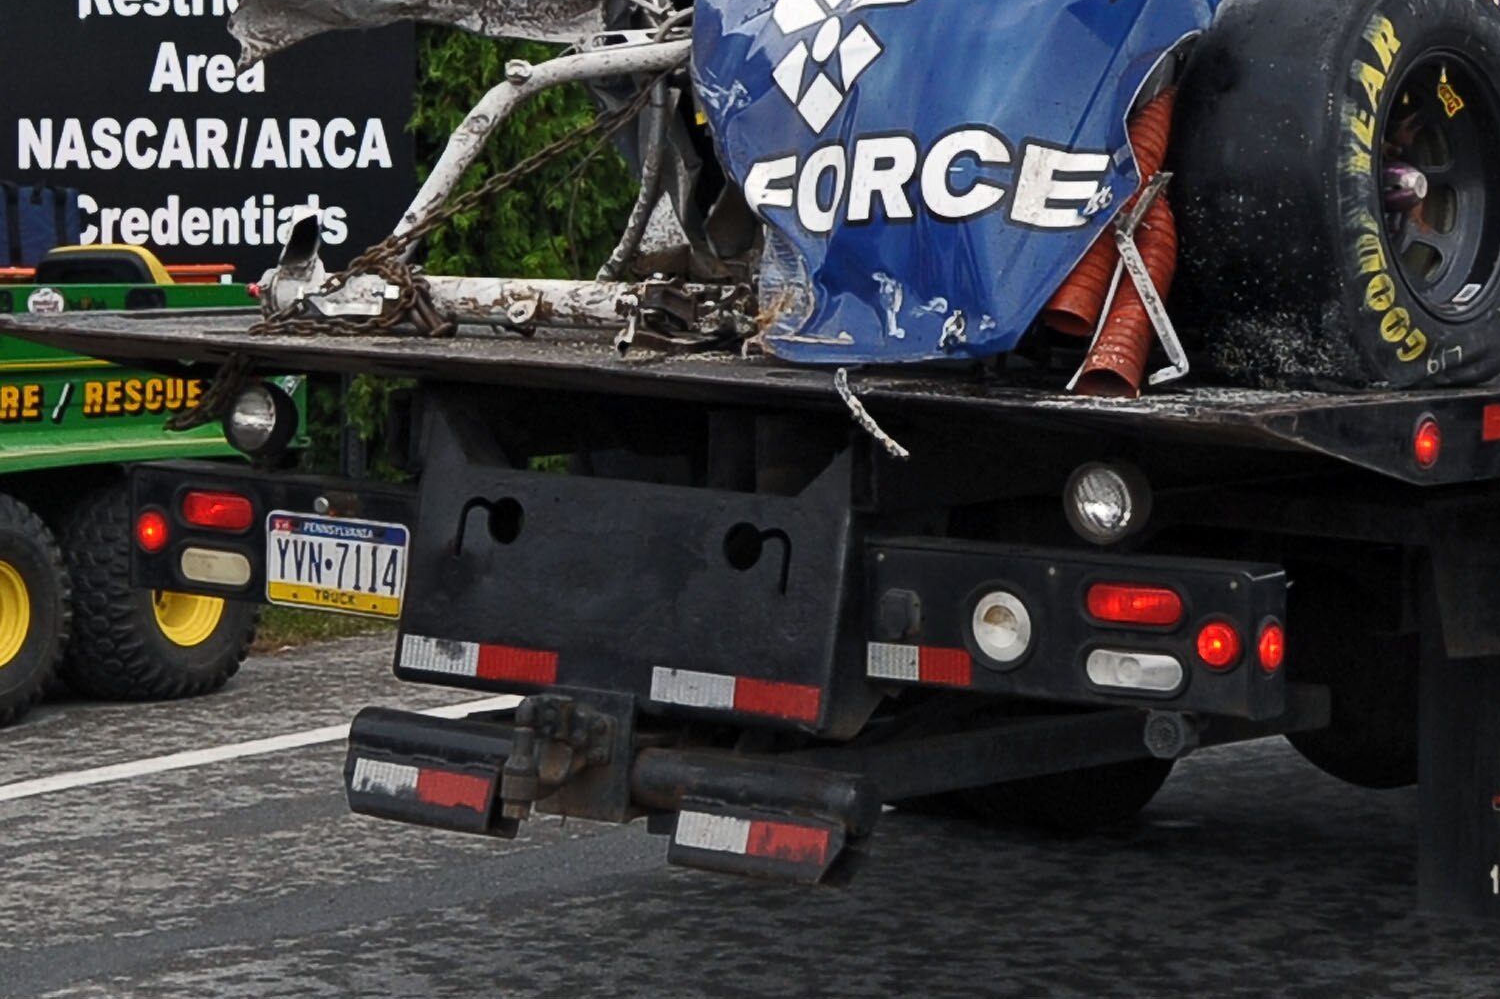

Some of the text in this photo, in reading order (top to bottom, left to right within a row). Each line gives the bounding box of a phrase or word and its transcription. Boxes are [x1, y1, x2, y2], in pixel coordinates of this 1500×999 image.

[149, 41, 265, 93] Area
[18, 117, 393, 170] NASCAR/ARCA
[745, 130, 1111, 232] FORCE
[0, 384, 41, 419] RE
[83, 377, 203, 413] RESCUE
[303, 521, 374, 539] PENNSYLVANIA
[314, 589, 356, 605] TRUCK
